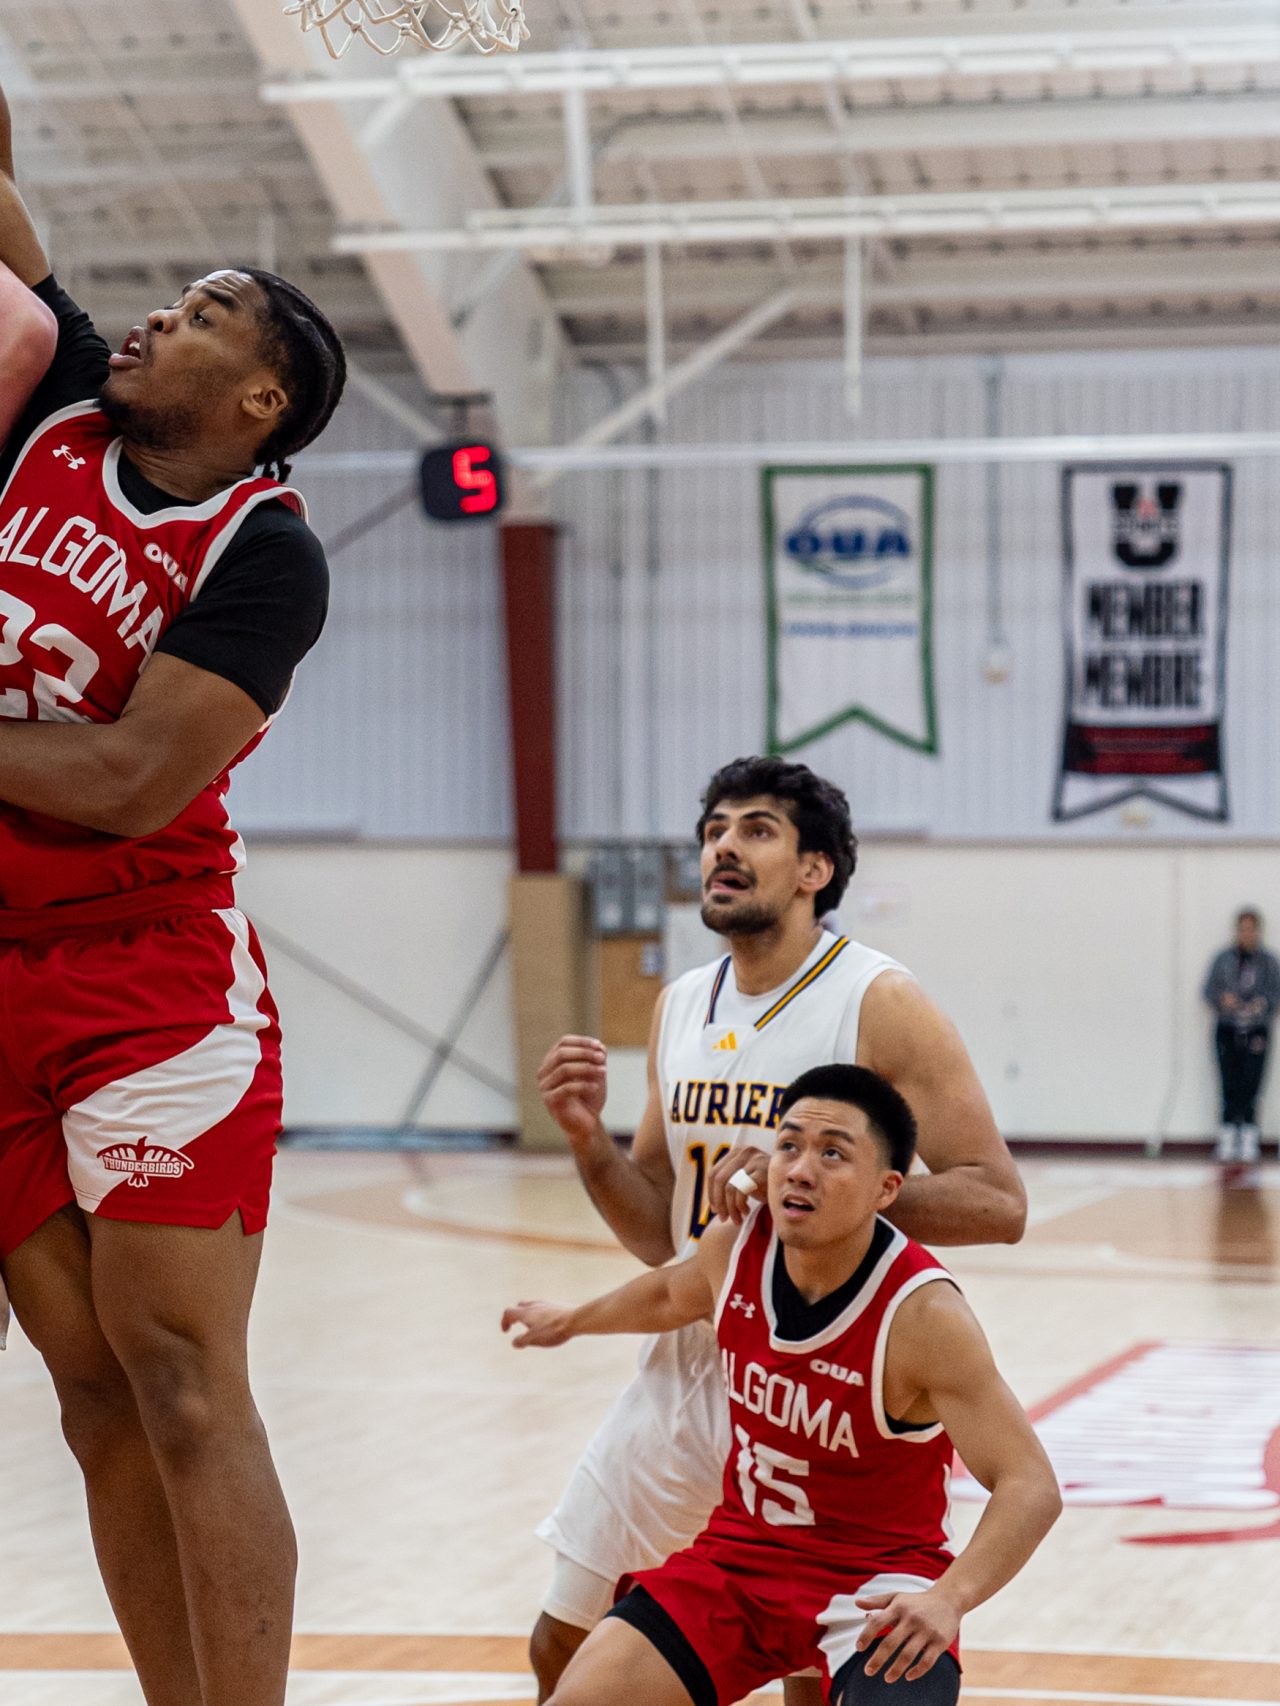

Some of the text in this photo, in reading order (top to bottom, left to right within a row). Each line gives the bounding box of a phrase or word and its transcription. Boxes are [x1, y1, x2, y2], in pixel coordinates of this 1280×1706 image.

[451, 446, 497, 514] 5
[144, 542, 189, 592] OUA
[786, 526, 911, 563] OUA
[670, 1079, 789, 1130] AURIER
[103, 1155, 182, 1176] THUNDERBIRDS
[687, 1142, 732, 1242] 1
[809, 1359, 865, 1387] OUA
[735, 1423, 816, 1526] 15
